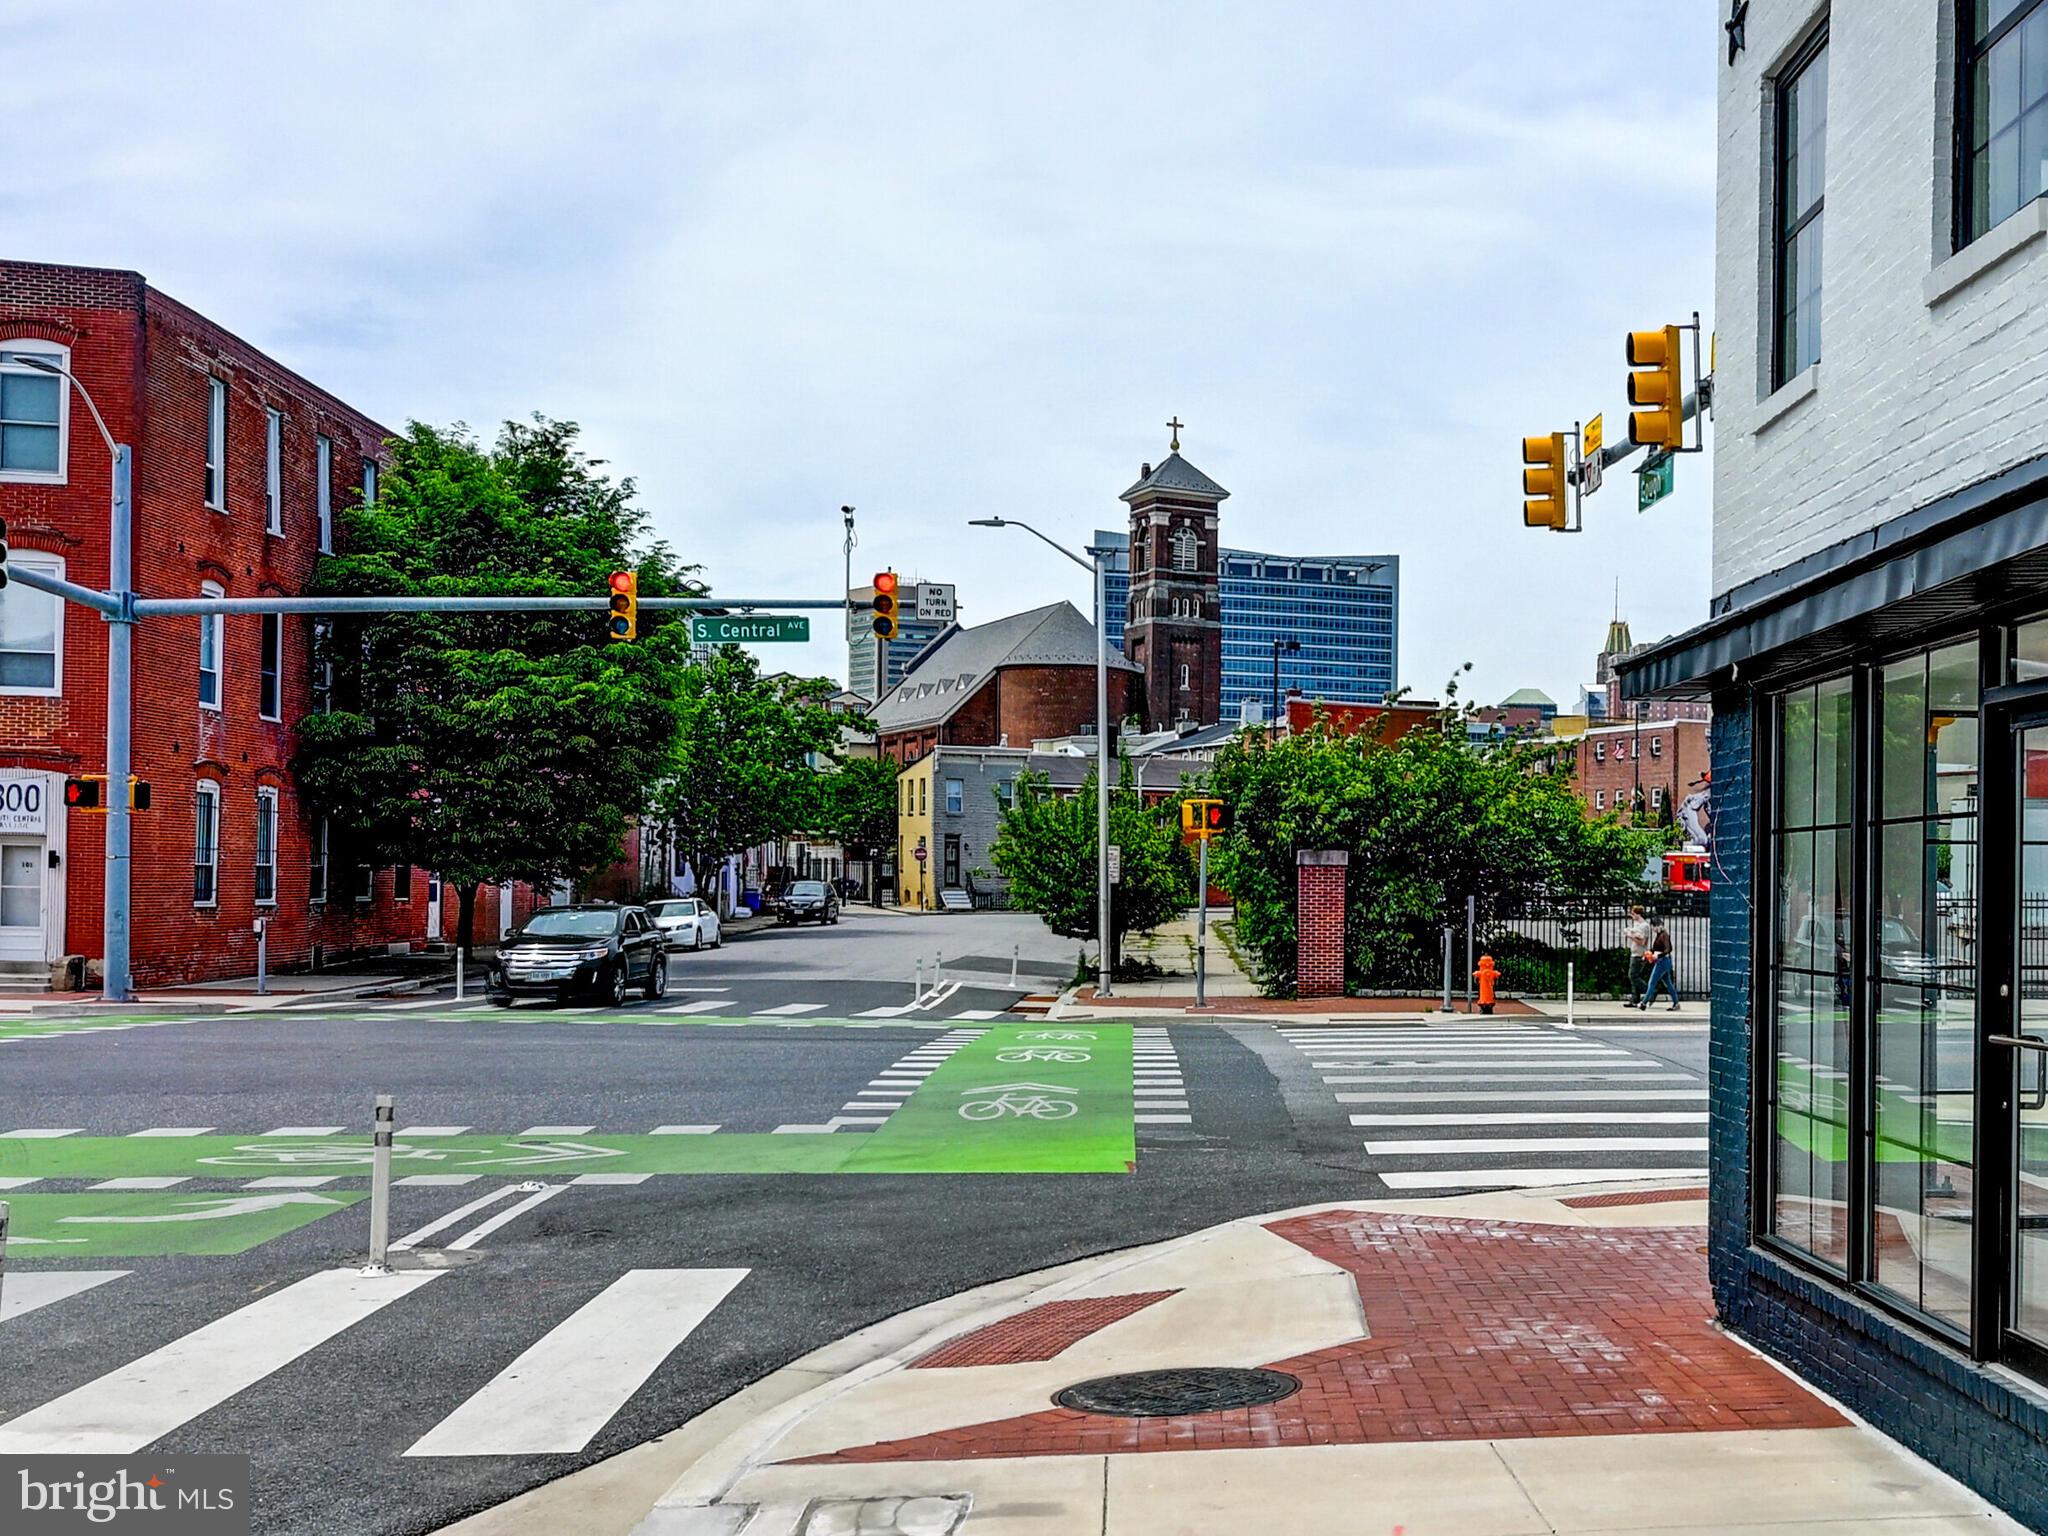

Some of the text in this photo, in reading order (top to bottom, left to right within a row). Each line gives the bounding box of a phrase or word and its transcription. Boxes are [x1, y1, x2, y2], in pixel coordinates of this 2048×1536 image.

[929, 588, 943, 596] NO
[925, 598, 947, 606] TURN
[920, 608, 951, 617] ON RED
[697, 621, 805, 638] S. Central AVE
